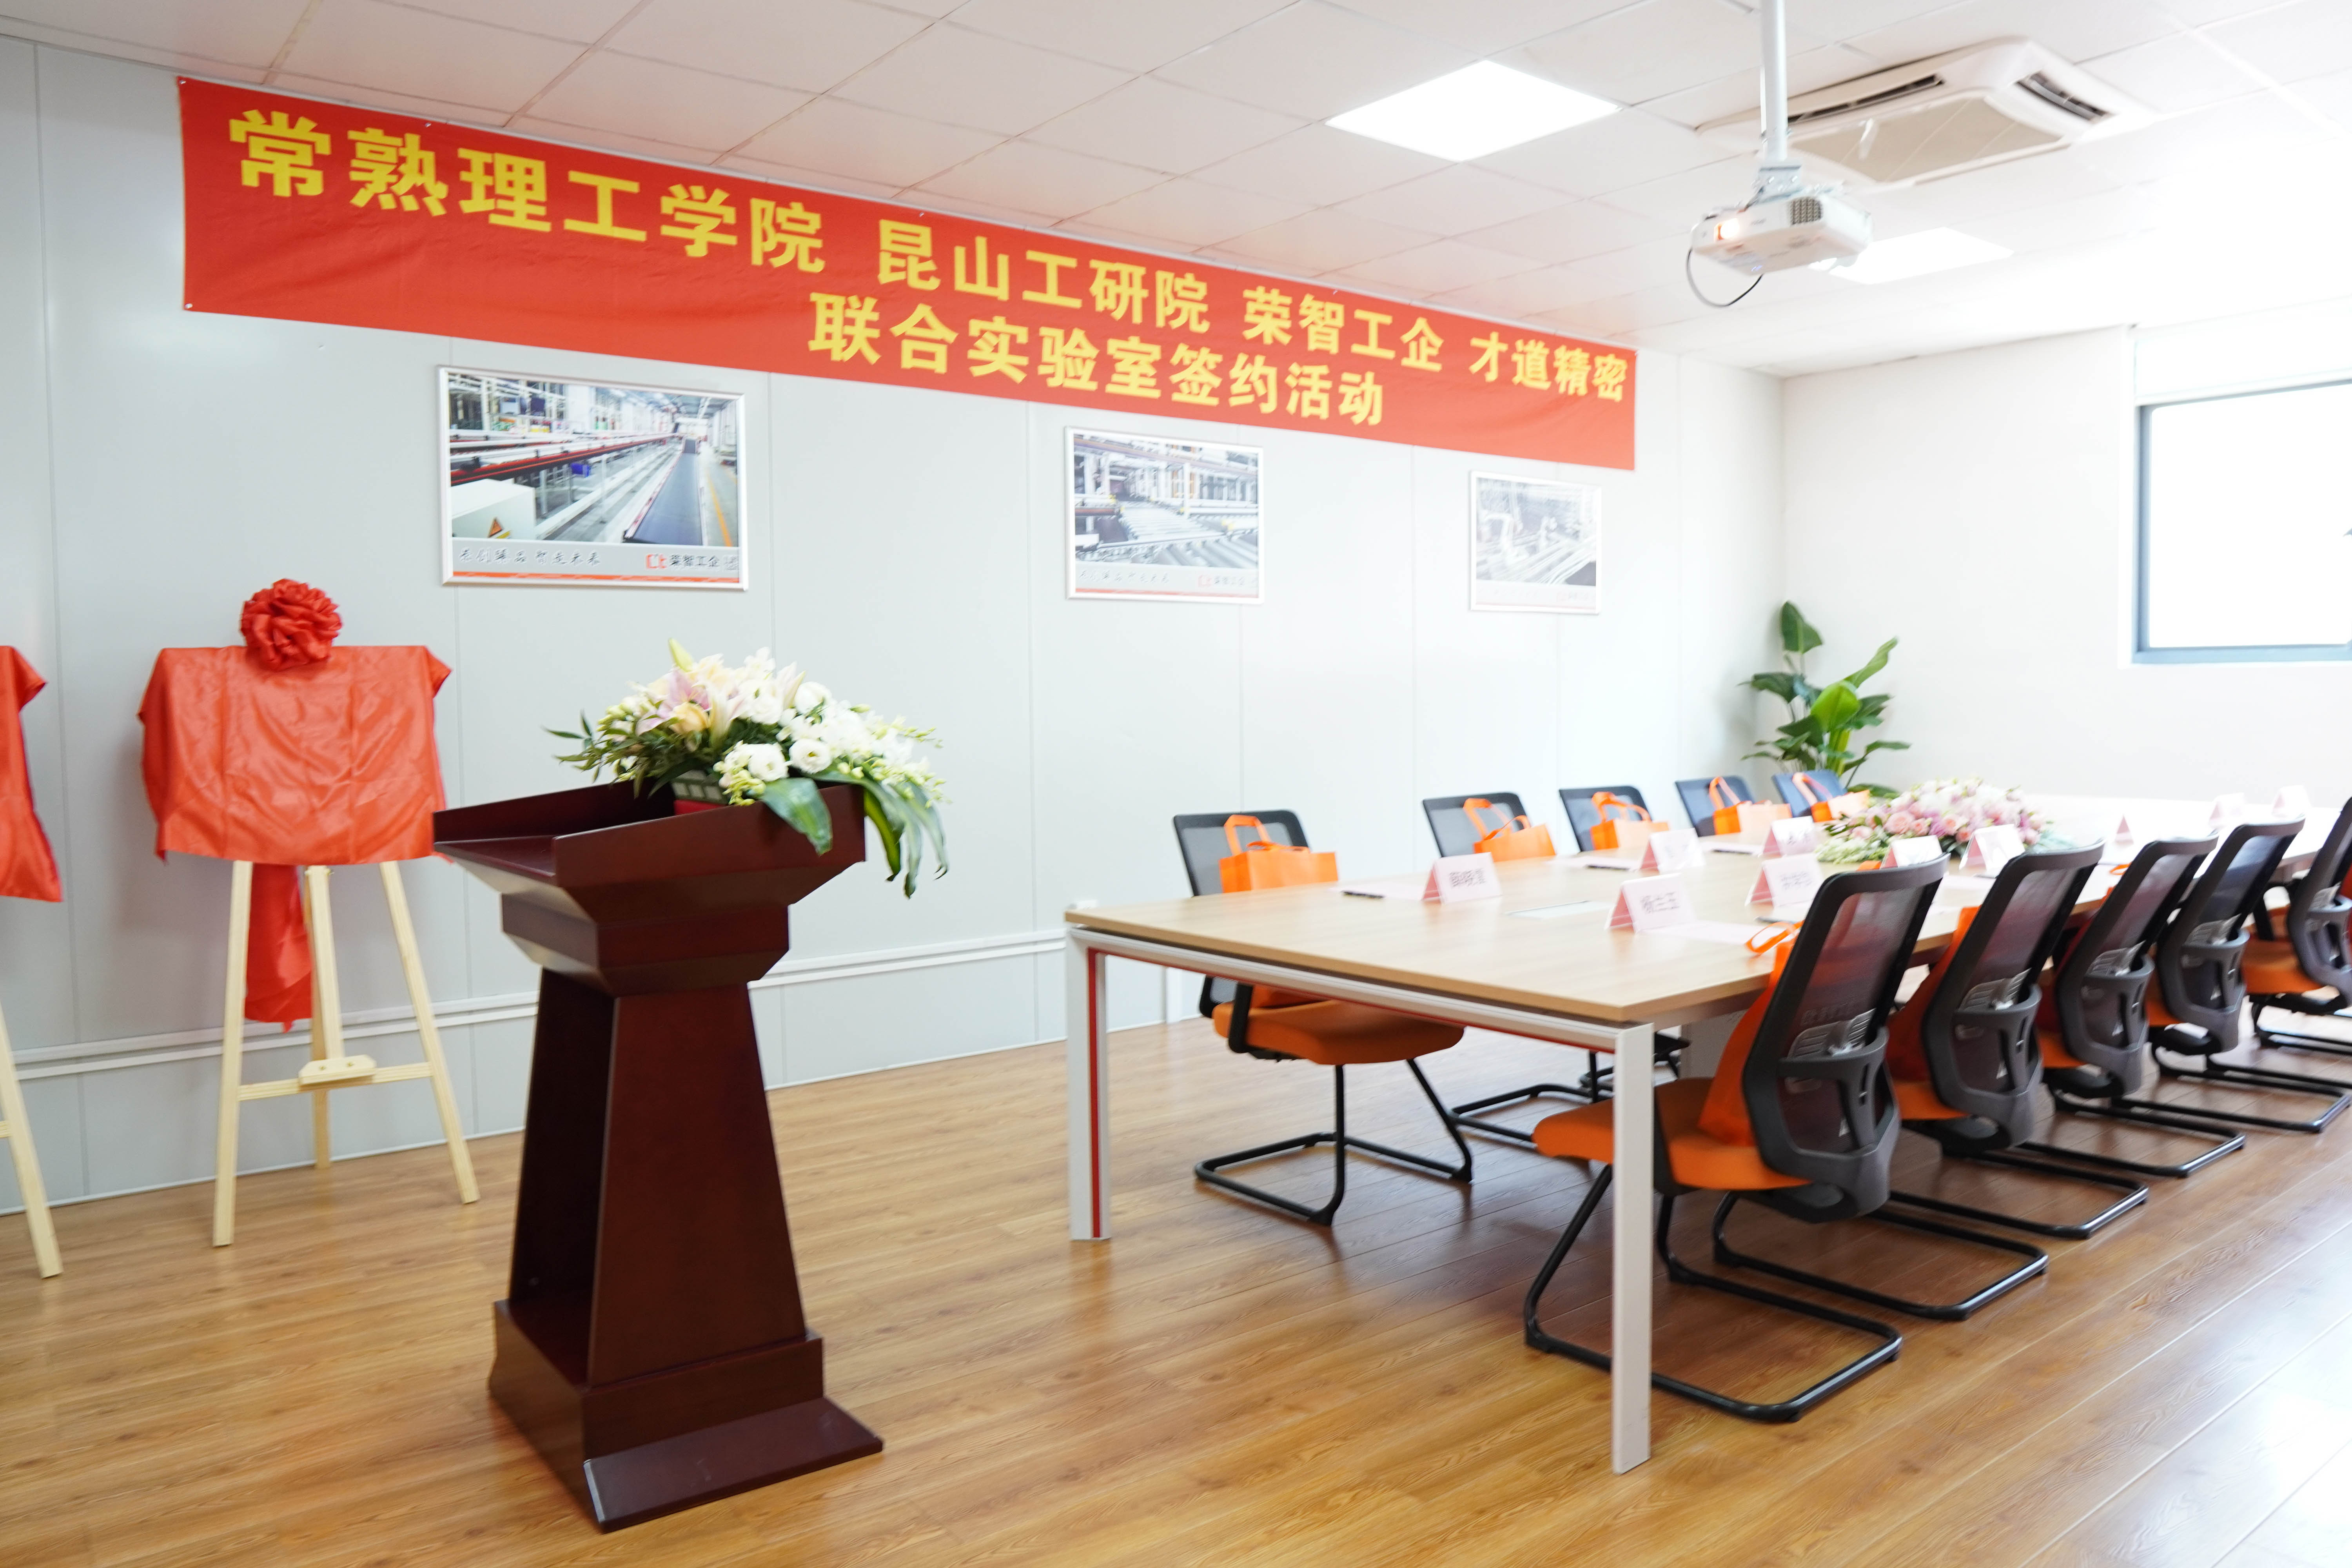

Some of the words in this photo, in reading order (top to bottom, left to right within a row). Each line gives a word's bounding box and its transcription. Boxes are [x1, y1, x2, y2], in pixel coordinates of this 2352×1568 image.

[229, 110, 826, 273] 常熟理工学院
[877, 220, 1210, 333] 昆山工研院
[1243, 285, 1443, 372] 荣智工企
[1470, 332, 1628, 402] 才道精密
[808, 292, 1383, 425] 联合实验室签约活动
